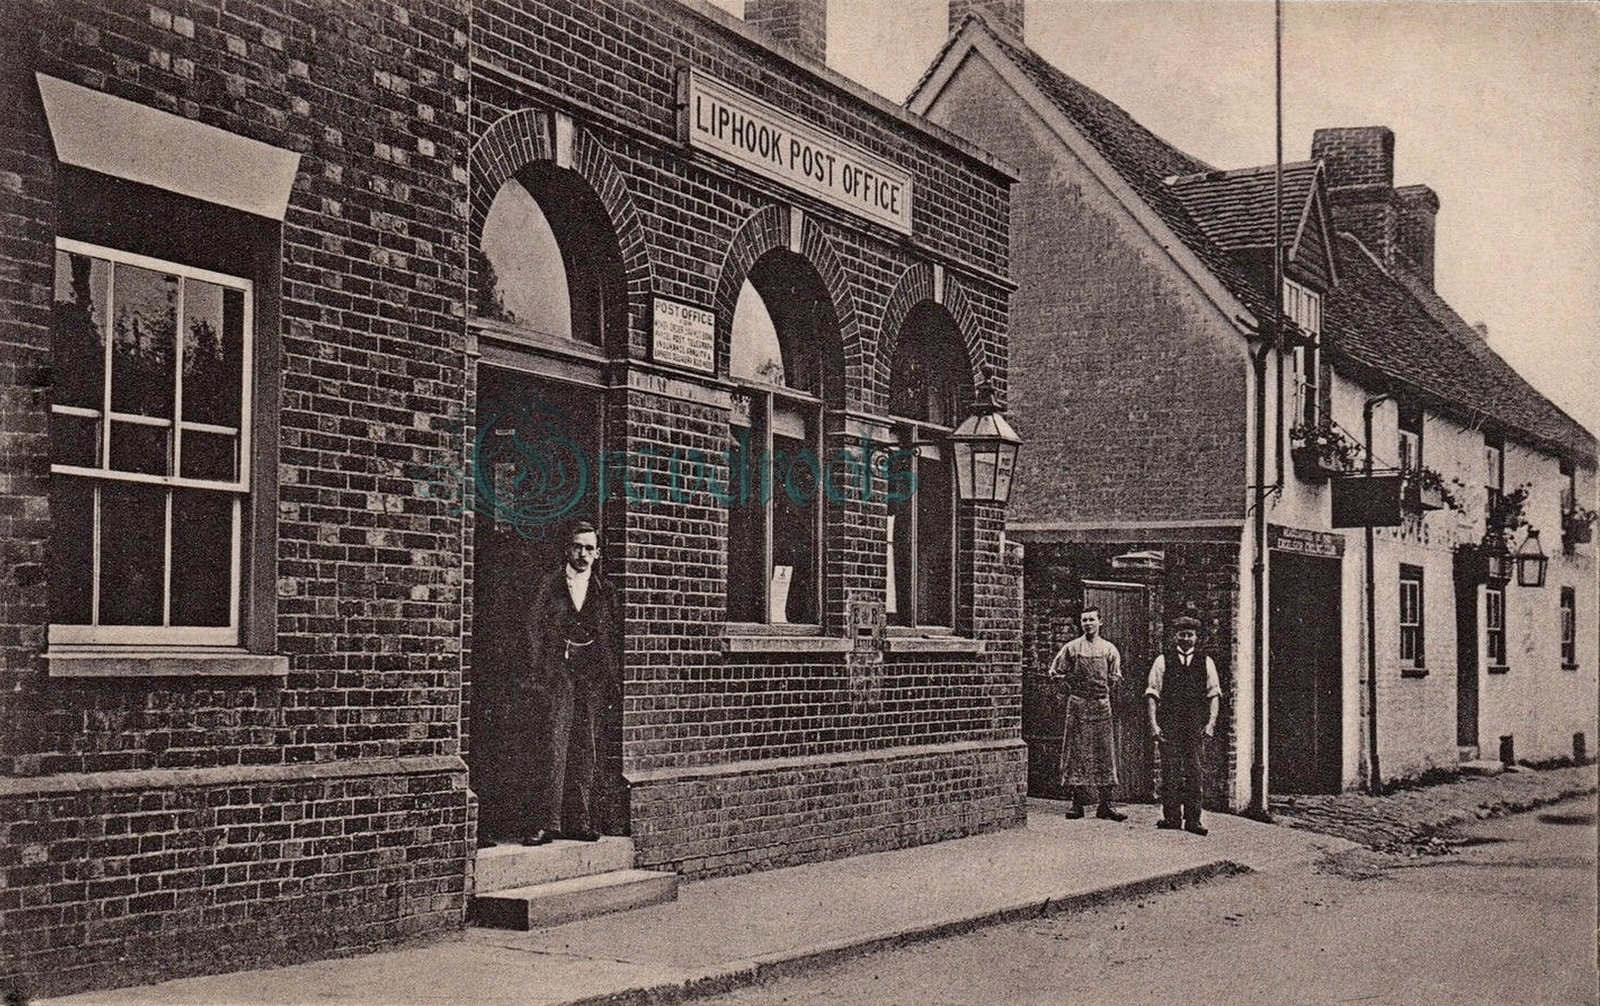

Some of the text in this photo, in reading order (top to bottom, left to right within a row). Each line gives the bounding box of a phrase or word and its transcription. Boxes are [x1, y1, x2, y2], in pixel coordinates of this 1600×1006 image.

[696, 96, 900, 215] LIPHOOK POST OFFICE
[655, 301, 680, 317] POST
[681, 308, 713, 326] OFFICE
